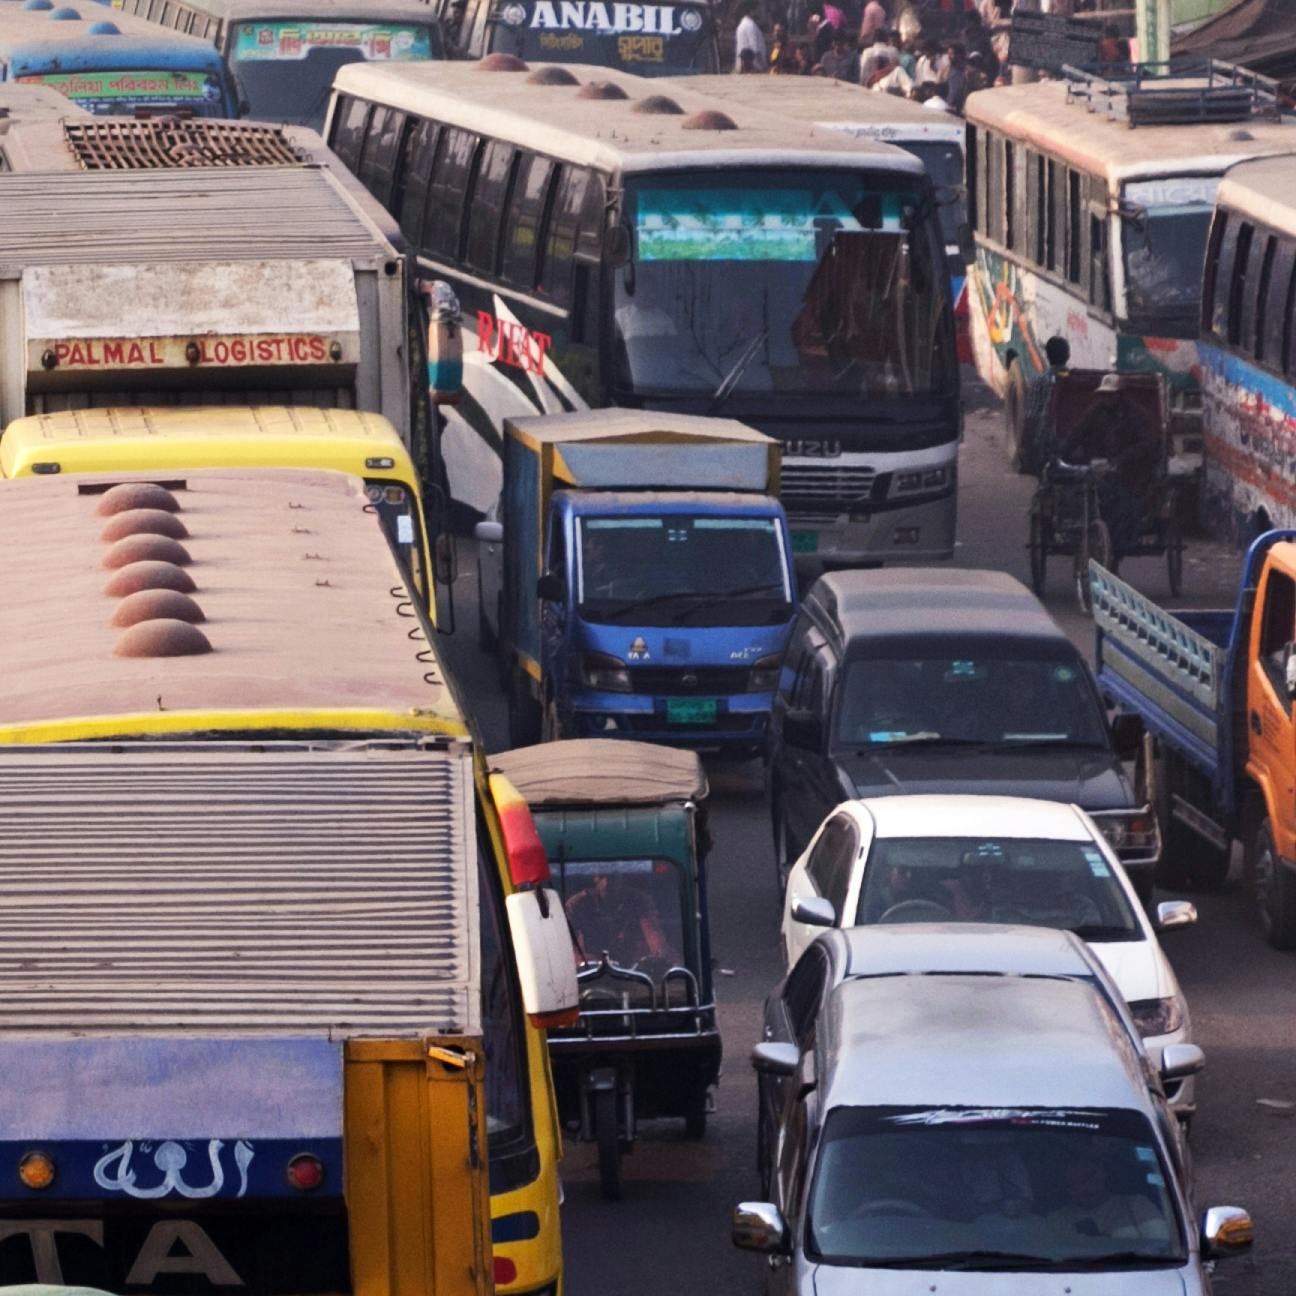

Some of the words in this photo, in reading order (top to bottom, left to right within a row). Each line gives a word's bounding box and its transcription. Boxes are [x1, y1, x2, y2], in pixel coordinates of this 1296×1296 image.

[529, 0, 683, 35] ANABIL
[54, 339, 164, 367] PALMAL
[199, 334, 328, 366] LOGISTICS
